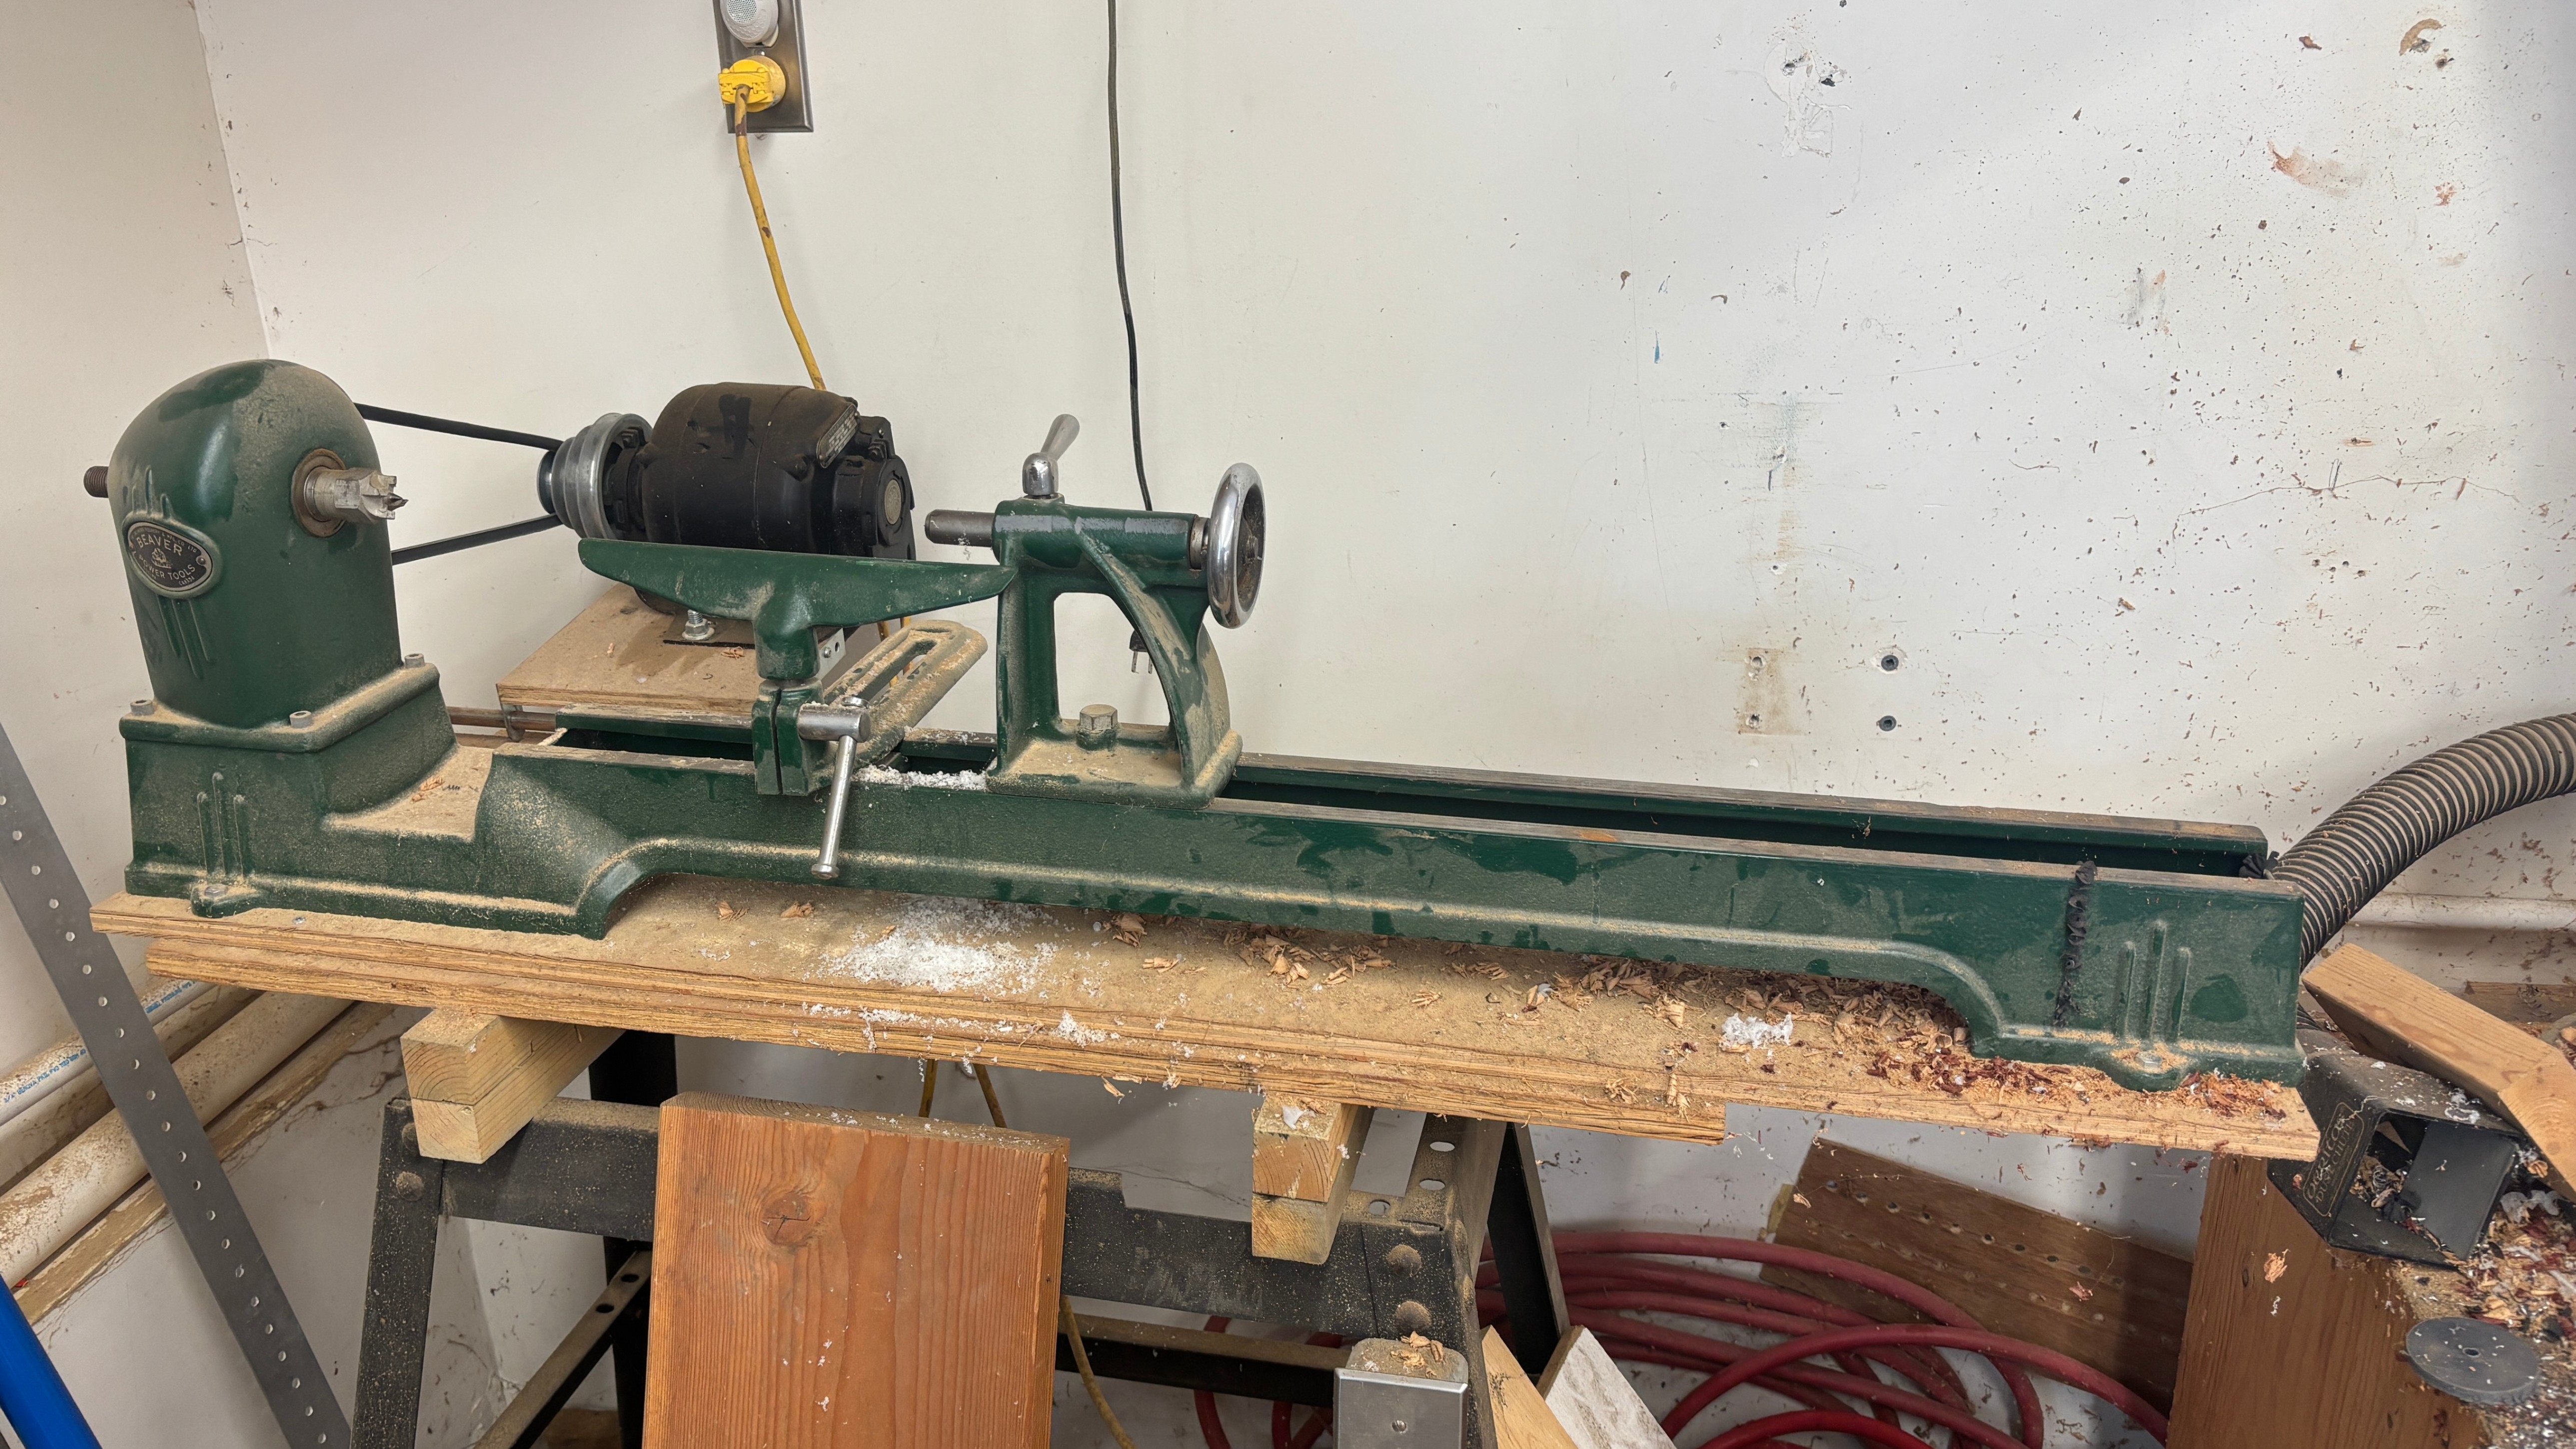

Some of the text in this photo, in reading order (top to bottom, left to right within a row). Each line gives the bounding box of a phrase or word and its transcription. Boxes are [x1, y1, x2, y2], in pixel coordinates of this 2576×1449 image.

[136, 534, 182, 556] BEAVER
[139, 554, 165, 579] POWER
[168, 564, 195, 580] TOOLS
